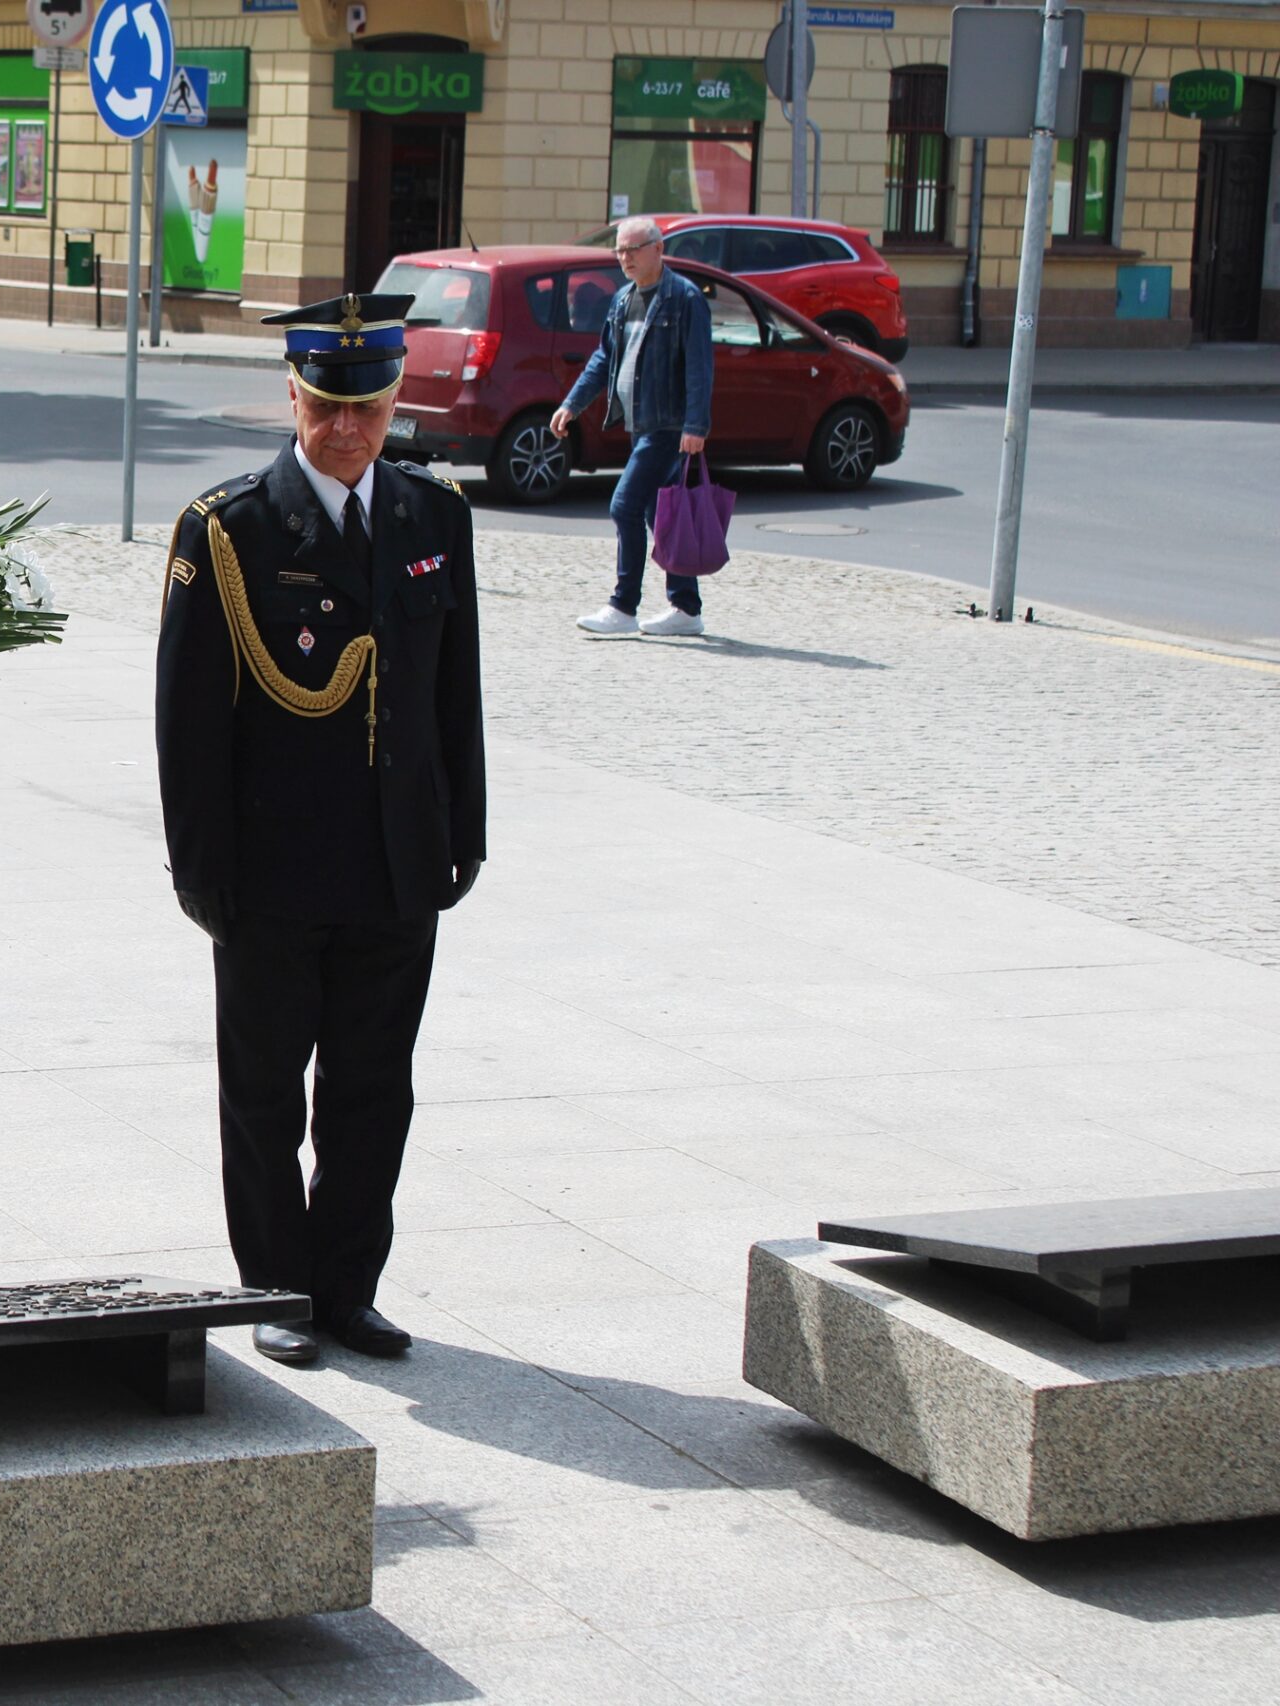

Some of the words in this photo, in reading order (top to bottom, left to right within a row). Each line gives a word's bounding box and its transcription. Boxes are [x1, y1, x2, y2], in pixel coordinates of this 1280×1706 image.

[807, 10, 835, 23] arszałka
[346, 63, 471, 99] żabka
[642, 81, 683, 96] 6-23/7
[697, 79, 731, 98] café
[1176, 81, 1230, 103] żabka
